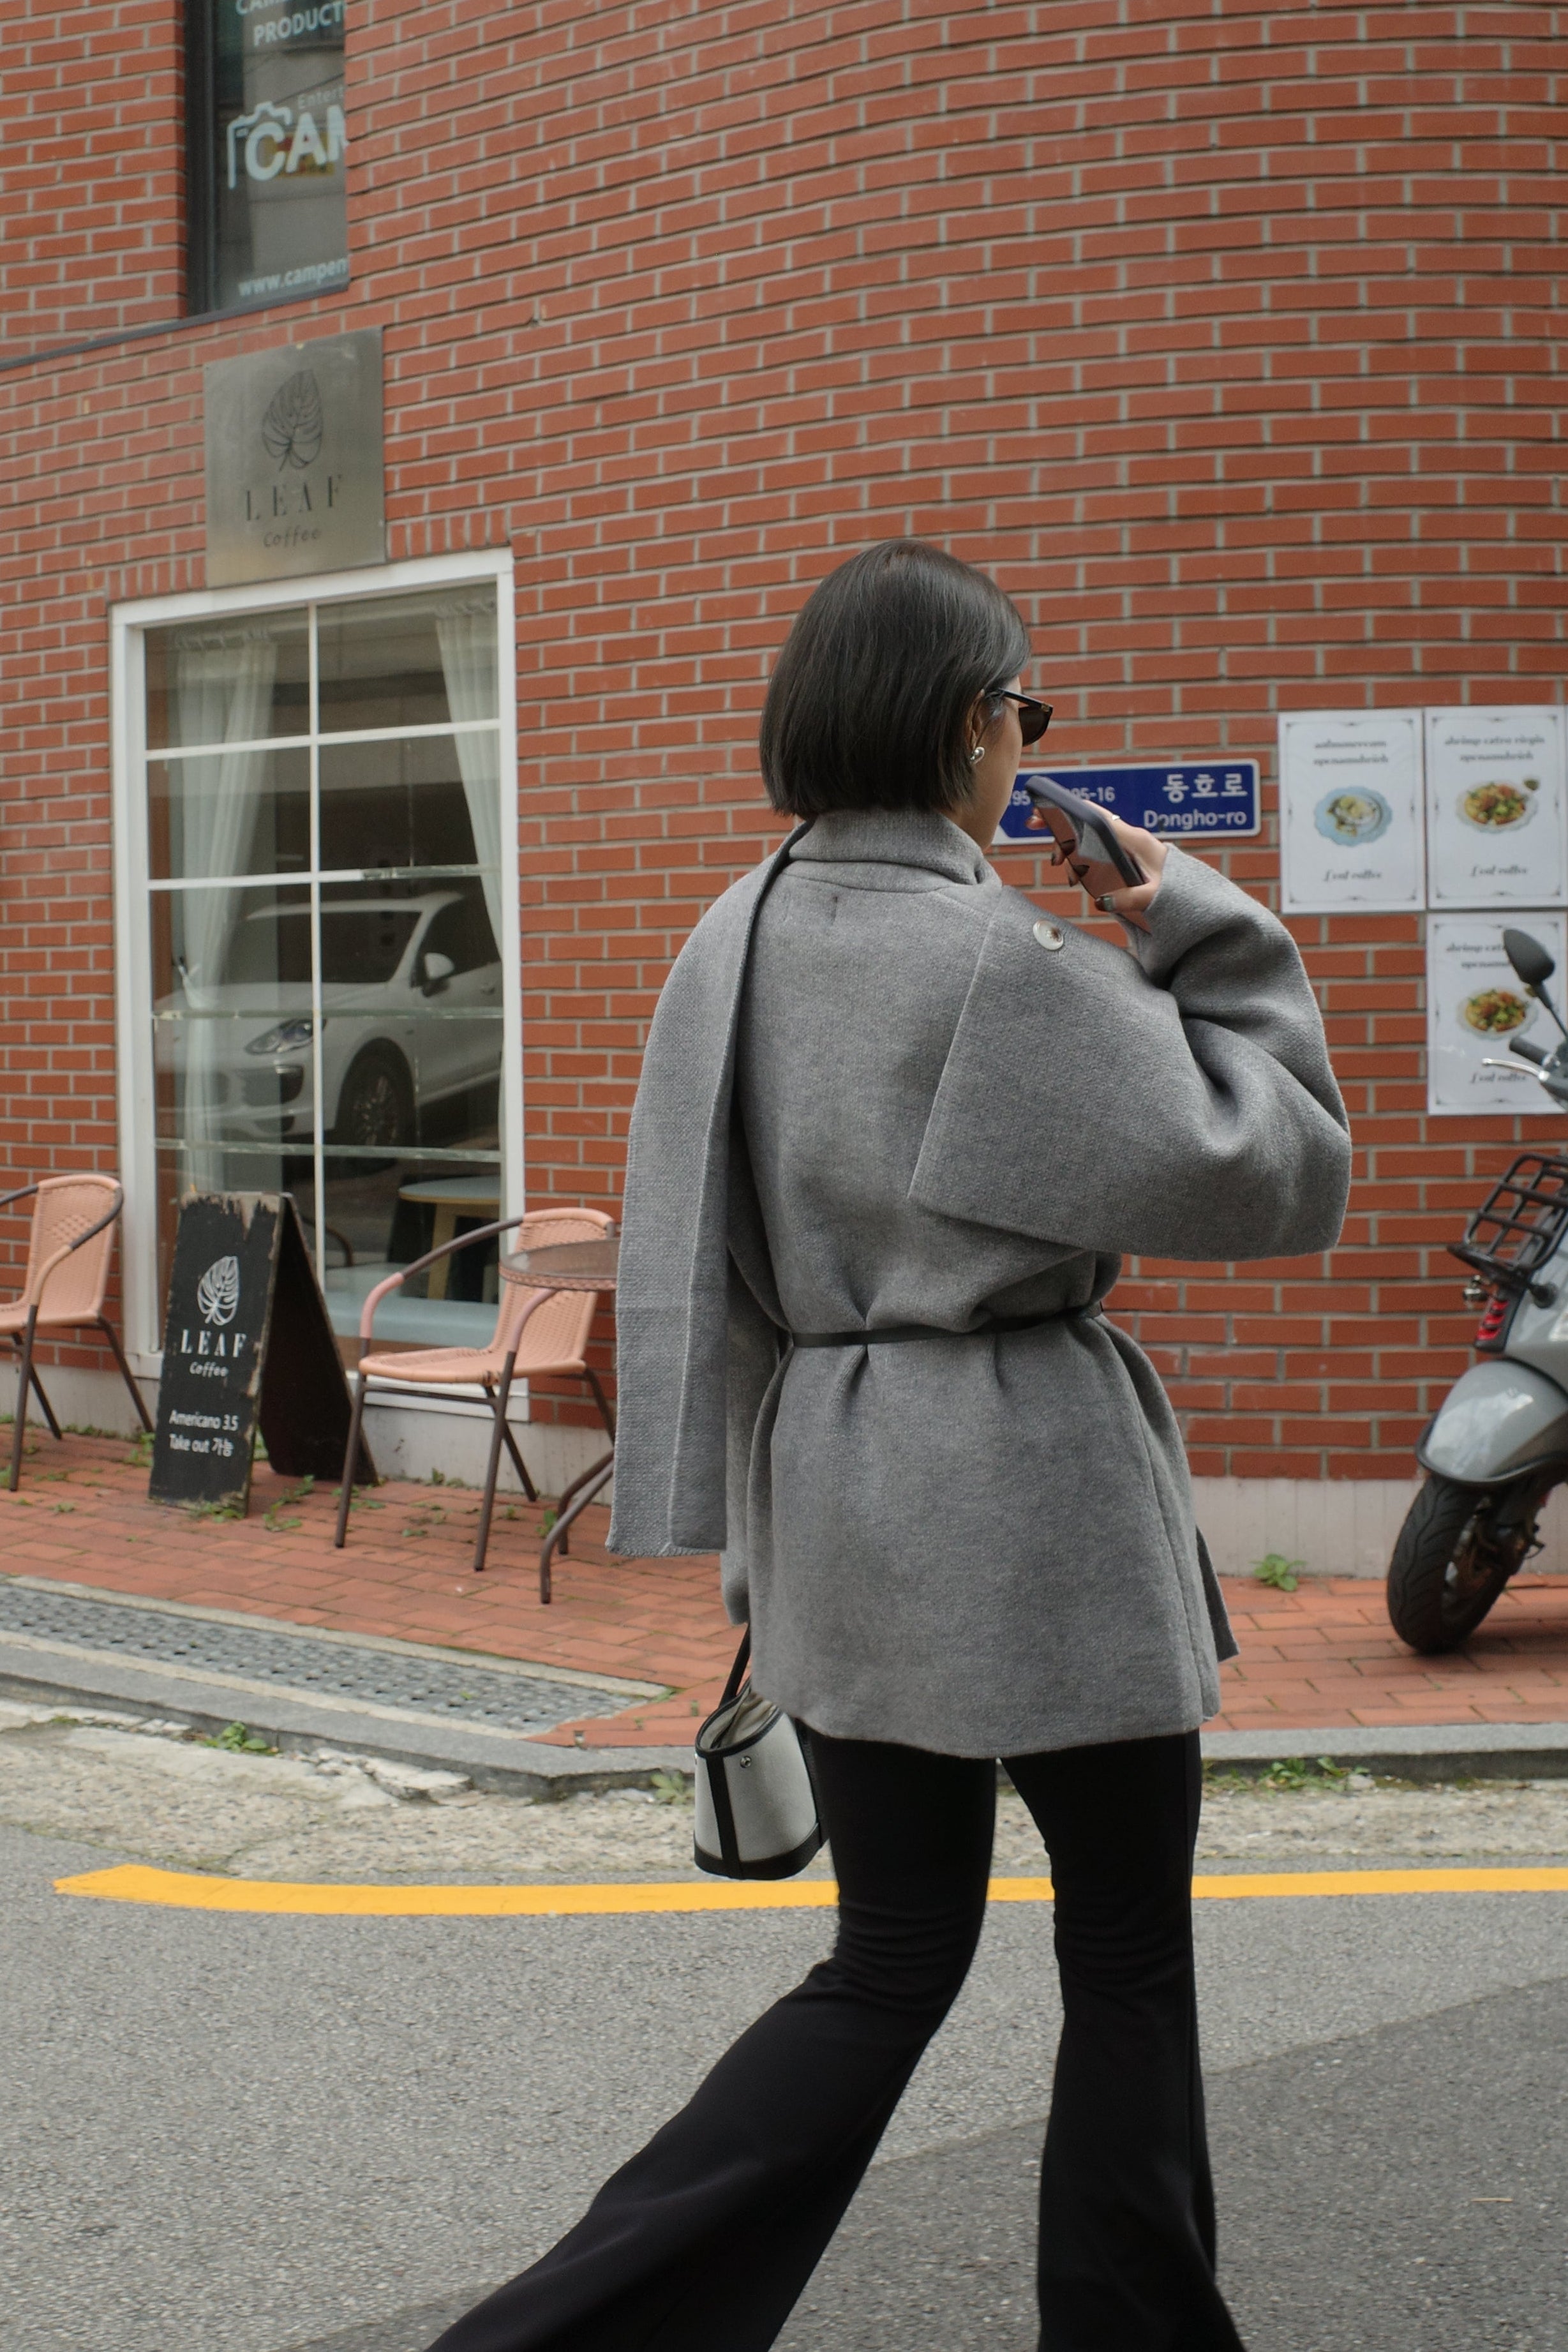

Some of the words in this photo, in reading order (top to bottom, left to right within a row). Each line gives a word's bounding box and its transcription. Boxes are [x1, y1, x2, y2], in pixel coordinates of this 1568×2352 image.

[246, 474, 343, 521] LEAF
[1010, 790, 1031, 806] 95
[1068, 786, 1116, 803] 95-16
[1162, 773, 1248, 803] 동호로
[1144, 809, 1247, 830] Dongho-ro
[181, 1329, 246, 1358] LEAF
[190, 1361, 228, 1377] Coffee
[168, 1409, 221, 1430] Americano
[169, 1433, 191, 1451] Take
[191, 1439, 210, 1453] out
